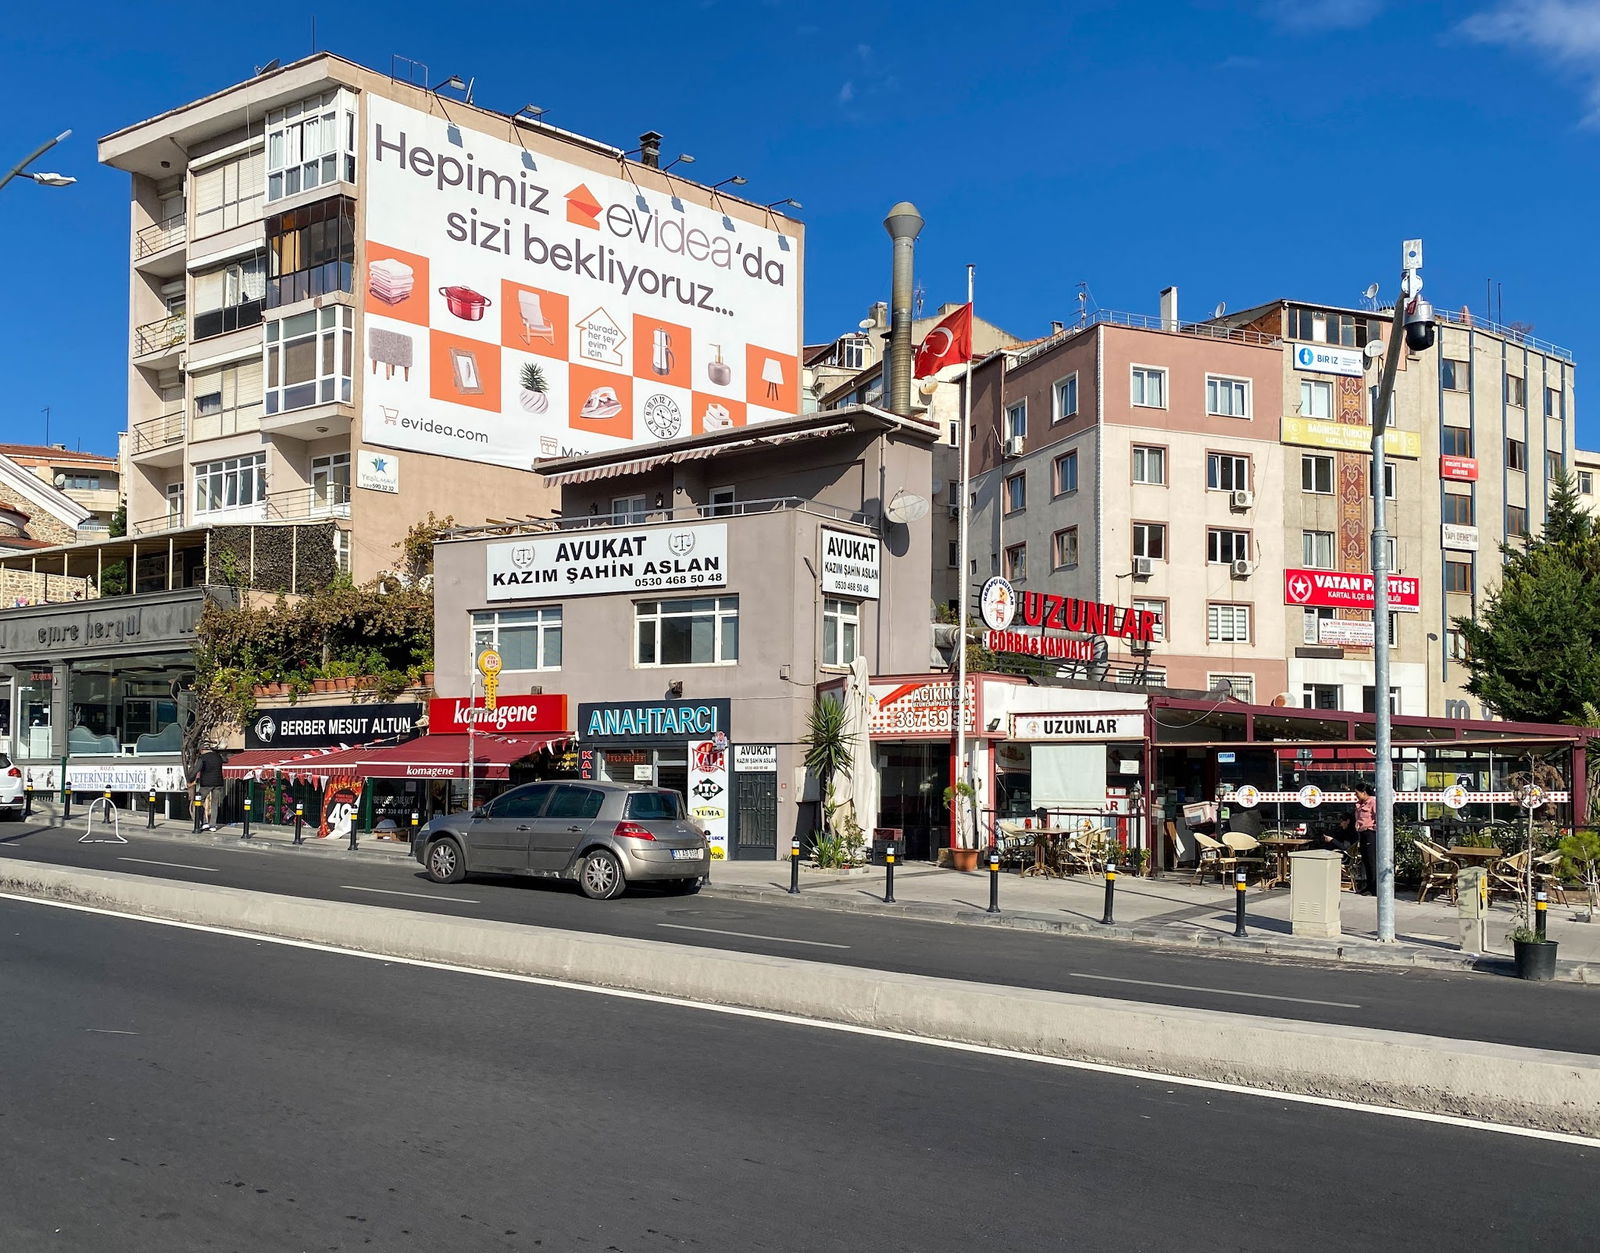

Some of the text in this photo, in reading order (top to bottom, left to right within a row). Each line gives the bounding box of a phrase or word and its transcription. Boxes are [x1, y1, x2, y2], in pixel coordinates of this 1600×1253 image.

[375, 123, 550, 215] Hepimiz
[446, 207, 734, 317] sizi bekliyoruz...
[588, 321, 618, 336] burada
[588, 330, 616, 346] her şey
[588, 341, 607, 351] evim
[588, 348, 602, 358] için
[401, 417, 489, 443] evidea.com
[555, 536, 647, 562] AVUKAT
[827, 537, 876, 562] AVUKAT
[493, 556, 719, 586] KAZIM ŞAHİN ASLAN
[634, 572, 723, 587] 0530 468 50 48
[825, 562, 879, 580] KAZIM ŞAHİN ASLAN
[1314, 575, 1360, 591] VATAN
[1327, 591, 1351, 600] KARTAL
[1351, 592, 1366, 602] İLÇE
[1023, 590, 1156, 642] UZUNLAR
[989, 630, 1030, 652] ÇORBA
[1040, 636, 1094, 661] KAHVALTI
[453, 700, 538, 730] komagene
[587, 706, 718, 736] ANAHTARCI
[896, 710, 924, 728] 387
[928, 709, 949, 728] 59
[280, 717, 411, 736] BERBER MESUT ALTUN
[1043, 719, 1117, 735] UZUNLAR
[740, 745, 773, 756] AVUKAT
[69, 769, 147, 784] VETERİNER KLİNİĞİ
[406, 765, 454, 777] komagene
[698, 780, 719, 793] İTO
[696, 809, 721, 817] YUMA
